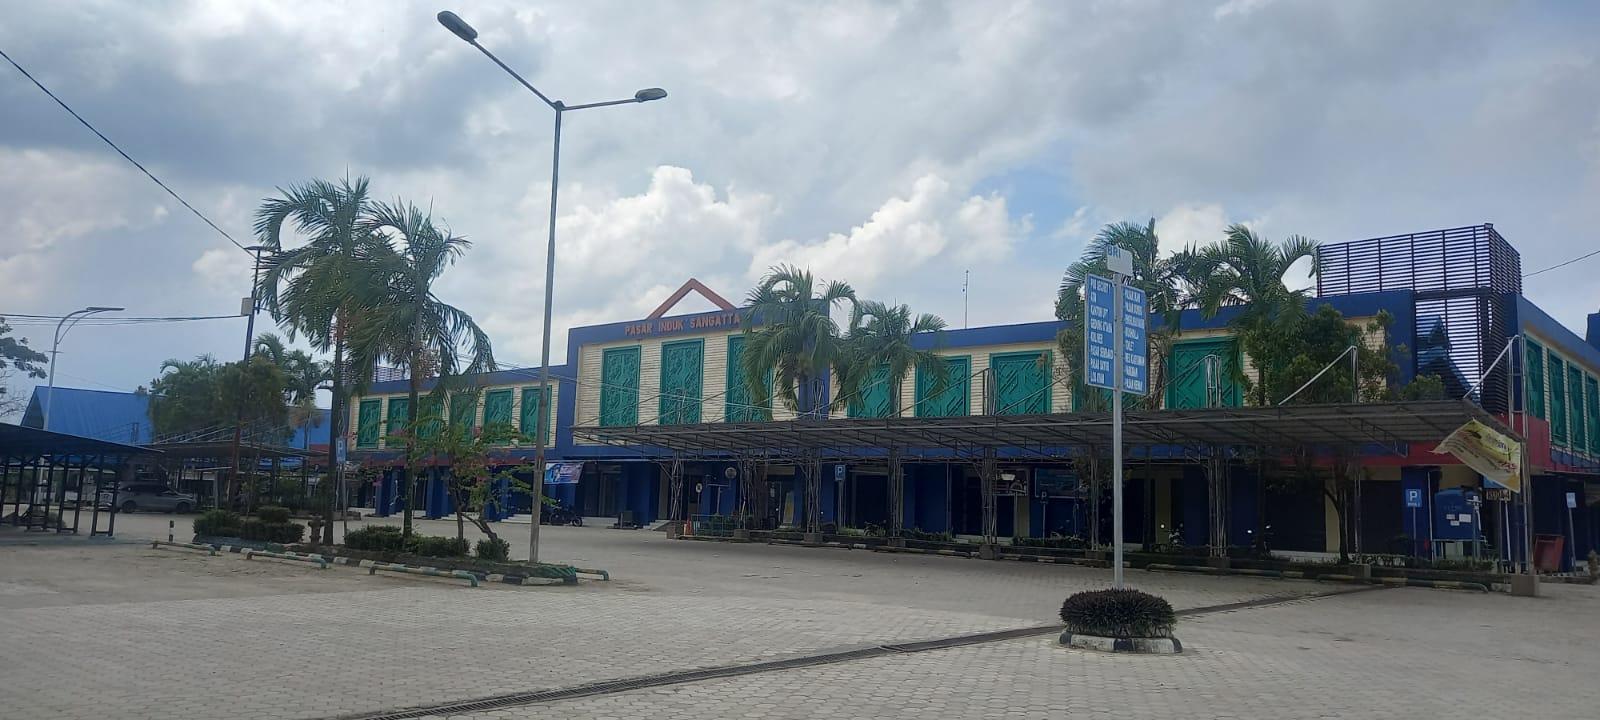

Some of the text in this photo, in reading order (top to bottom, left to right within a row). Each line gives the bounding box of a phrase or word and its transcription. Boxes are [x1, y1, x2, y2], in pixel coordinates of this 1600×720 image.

[1107, 245, 1121, 258] BRI
[624, 312, 741, 336] PASAR INDUK SANGATTA
[837, 466, 843, 477] P
[1409, 490, 1418, 502] P
